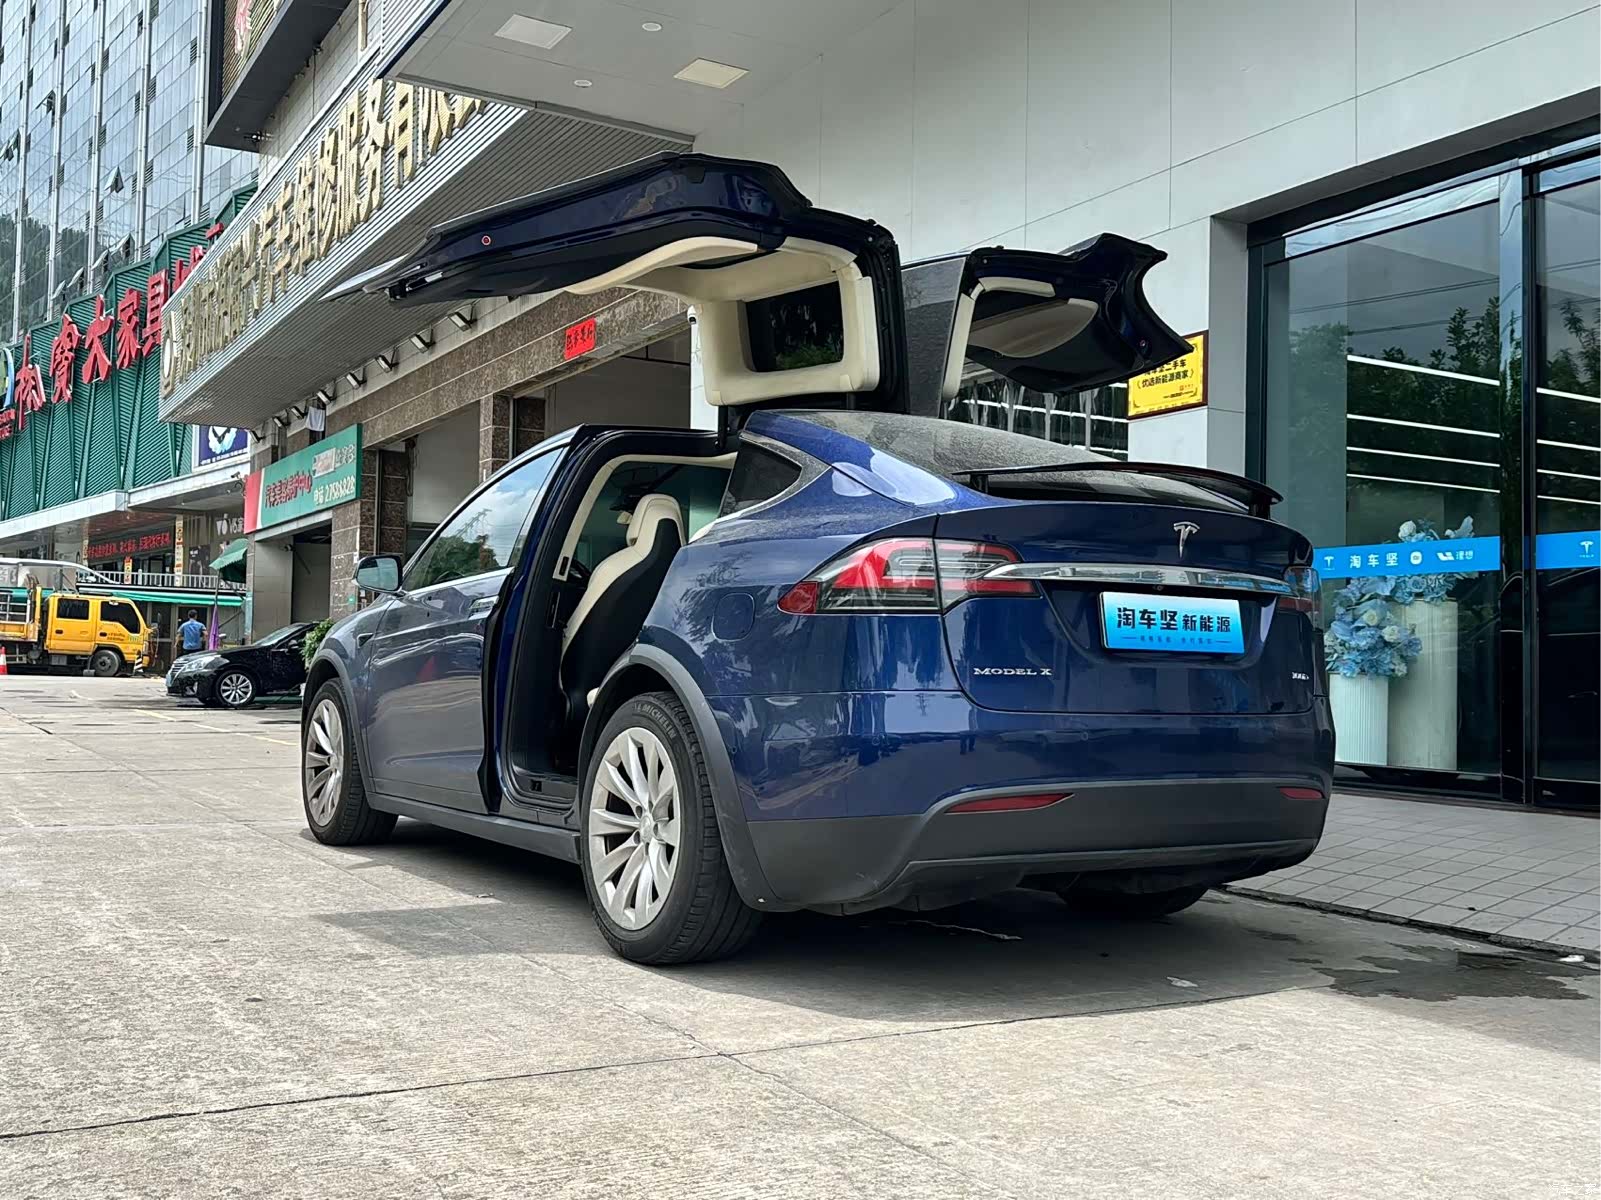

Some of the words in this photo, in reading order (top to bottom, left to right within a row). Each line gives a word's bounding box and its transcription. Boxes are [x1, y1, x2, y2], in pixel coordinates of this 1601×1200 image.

[1350, 552, 1398, 569] 淘车坚
[1456, 550, 1474, 560] 理想
[1117, 607, 1178, 631] 淘车坚
[1182, 613, 1231, 632] 新能源
[973, 667, 1037, 676] MODEL
[1040, 667, 1053, 676] X
[642, 703, 677, 739] MICHELIN
